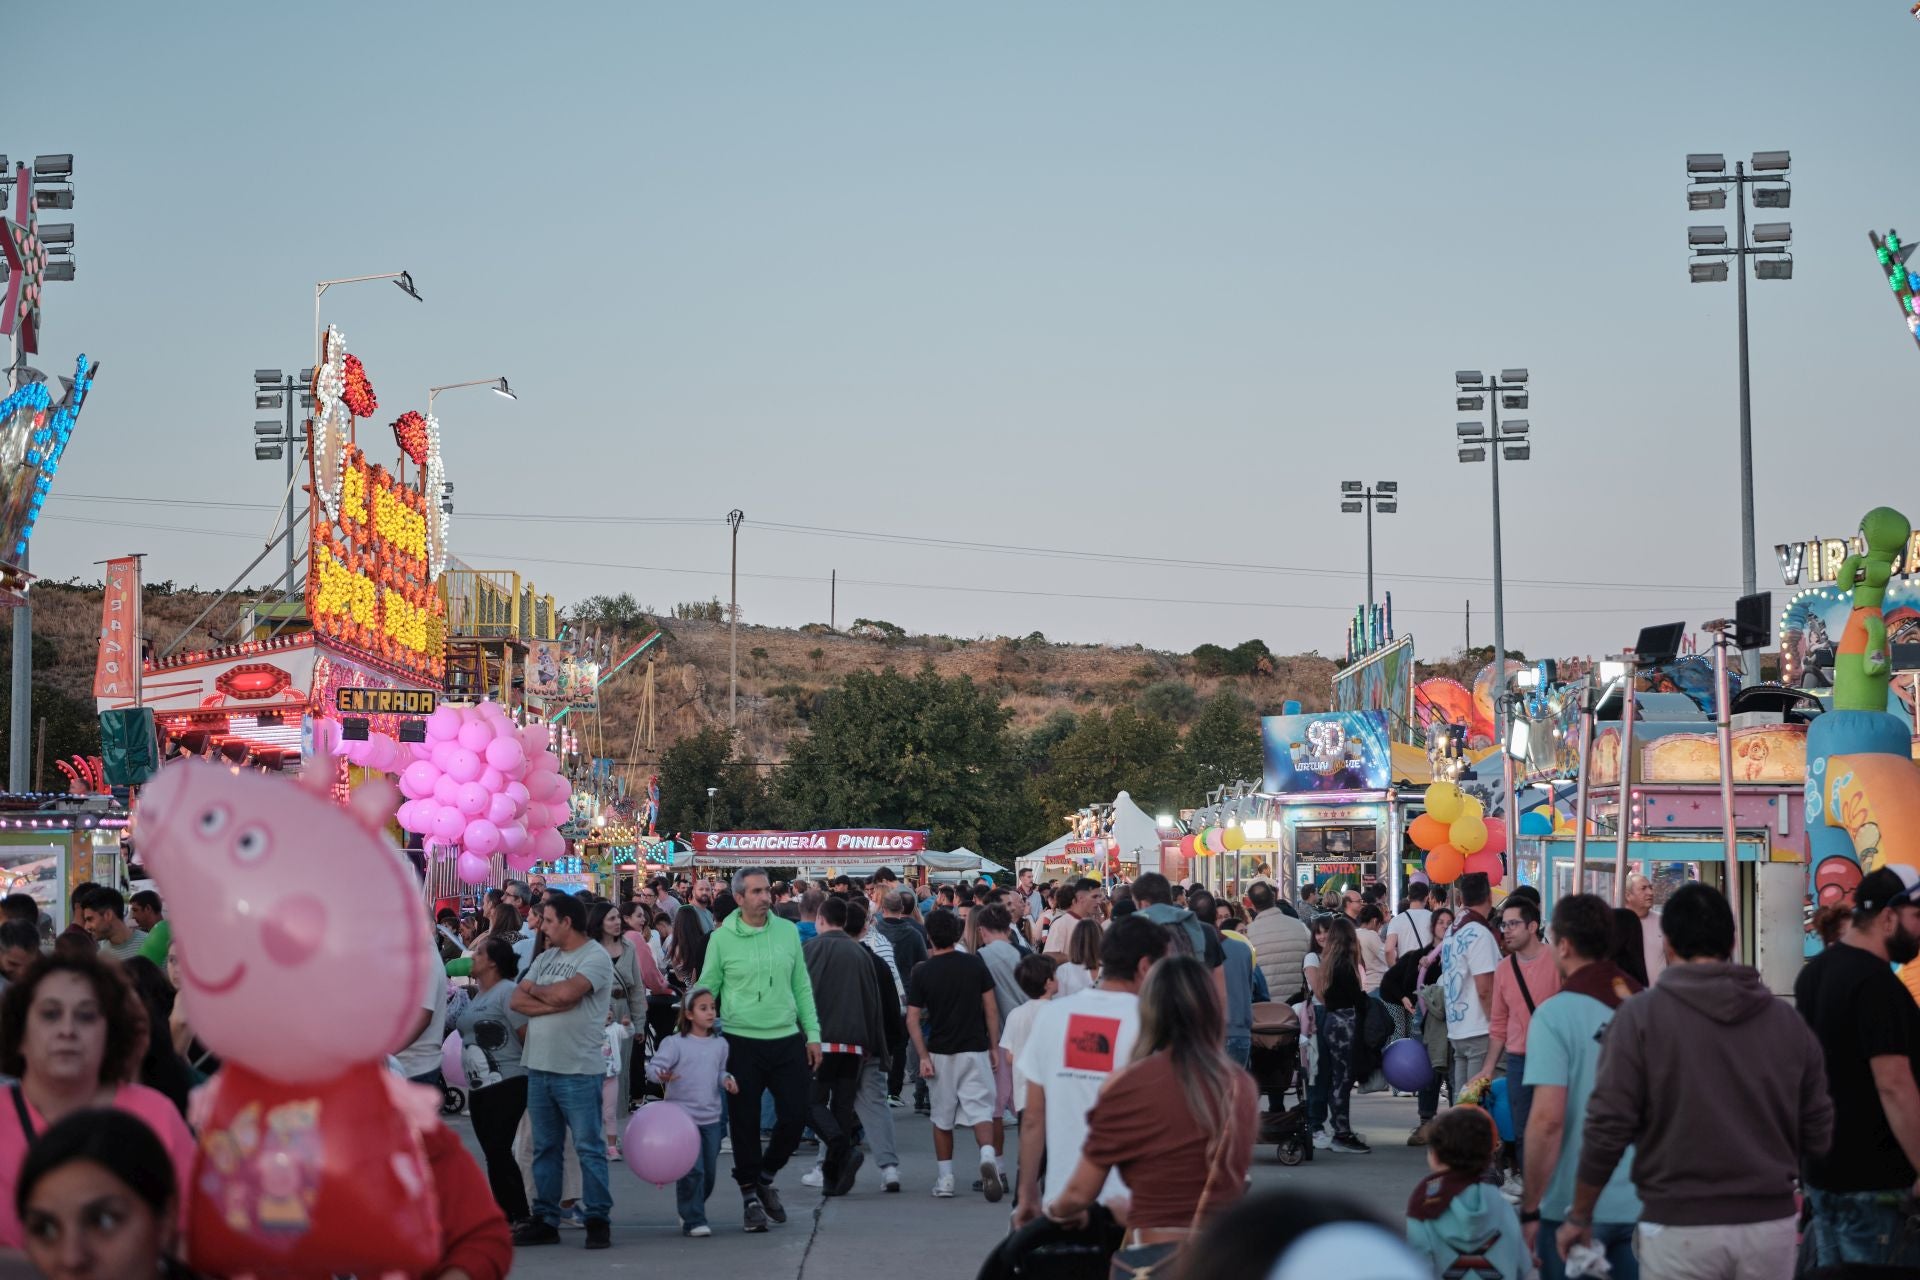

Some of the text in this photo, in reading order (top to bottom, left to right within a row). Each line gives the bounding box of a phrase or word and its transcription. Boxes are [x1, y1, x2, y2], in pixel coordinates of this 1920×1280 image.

[340, 689, 433, 712] ENTRADA
[1305, 720, 1345, 758] 9D
[705, 834, 913, 849] SALCHICHERÍA PINILLOS
[1067, 846, 1093, 855] SALIDA
